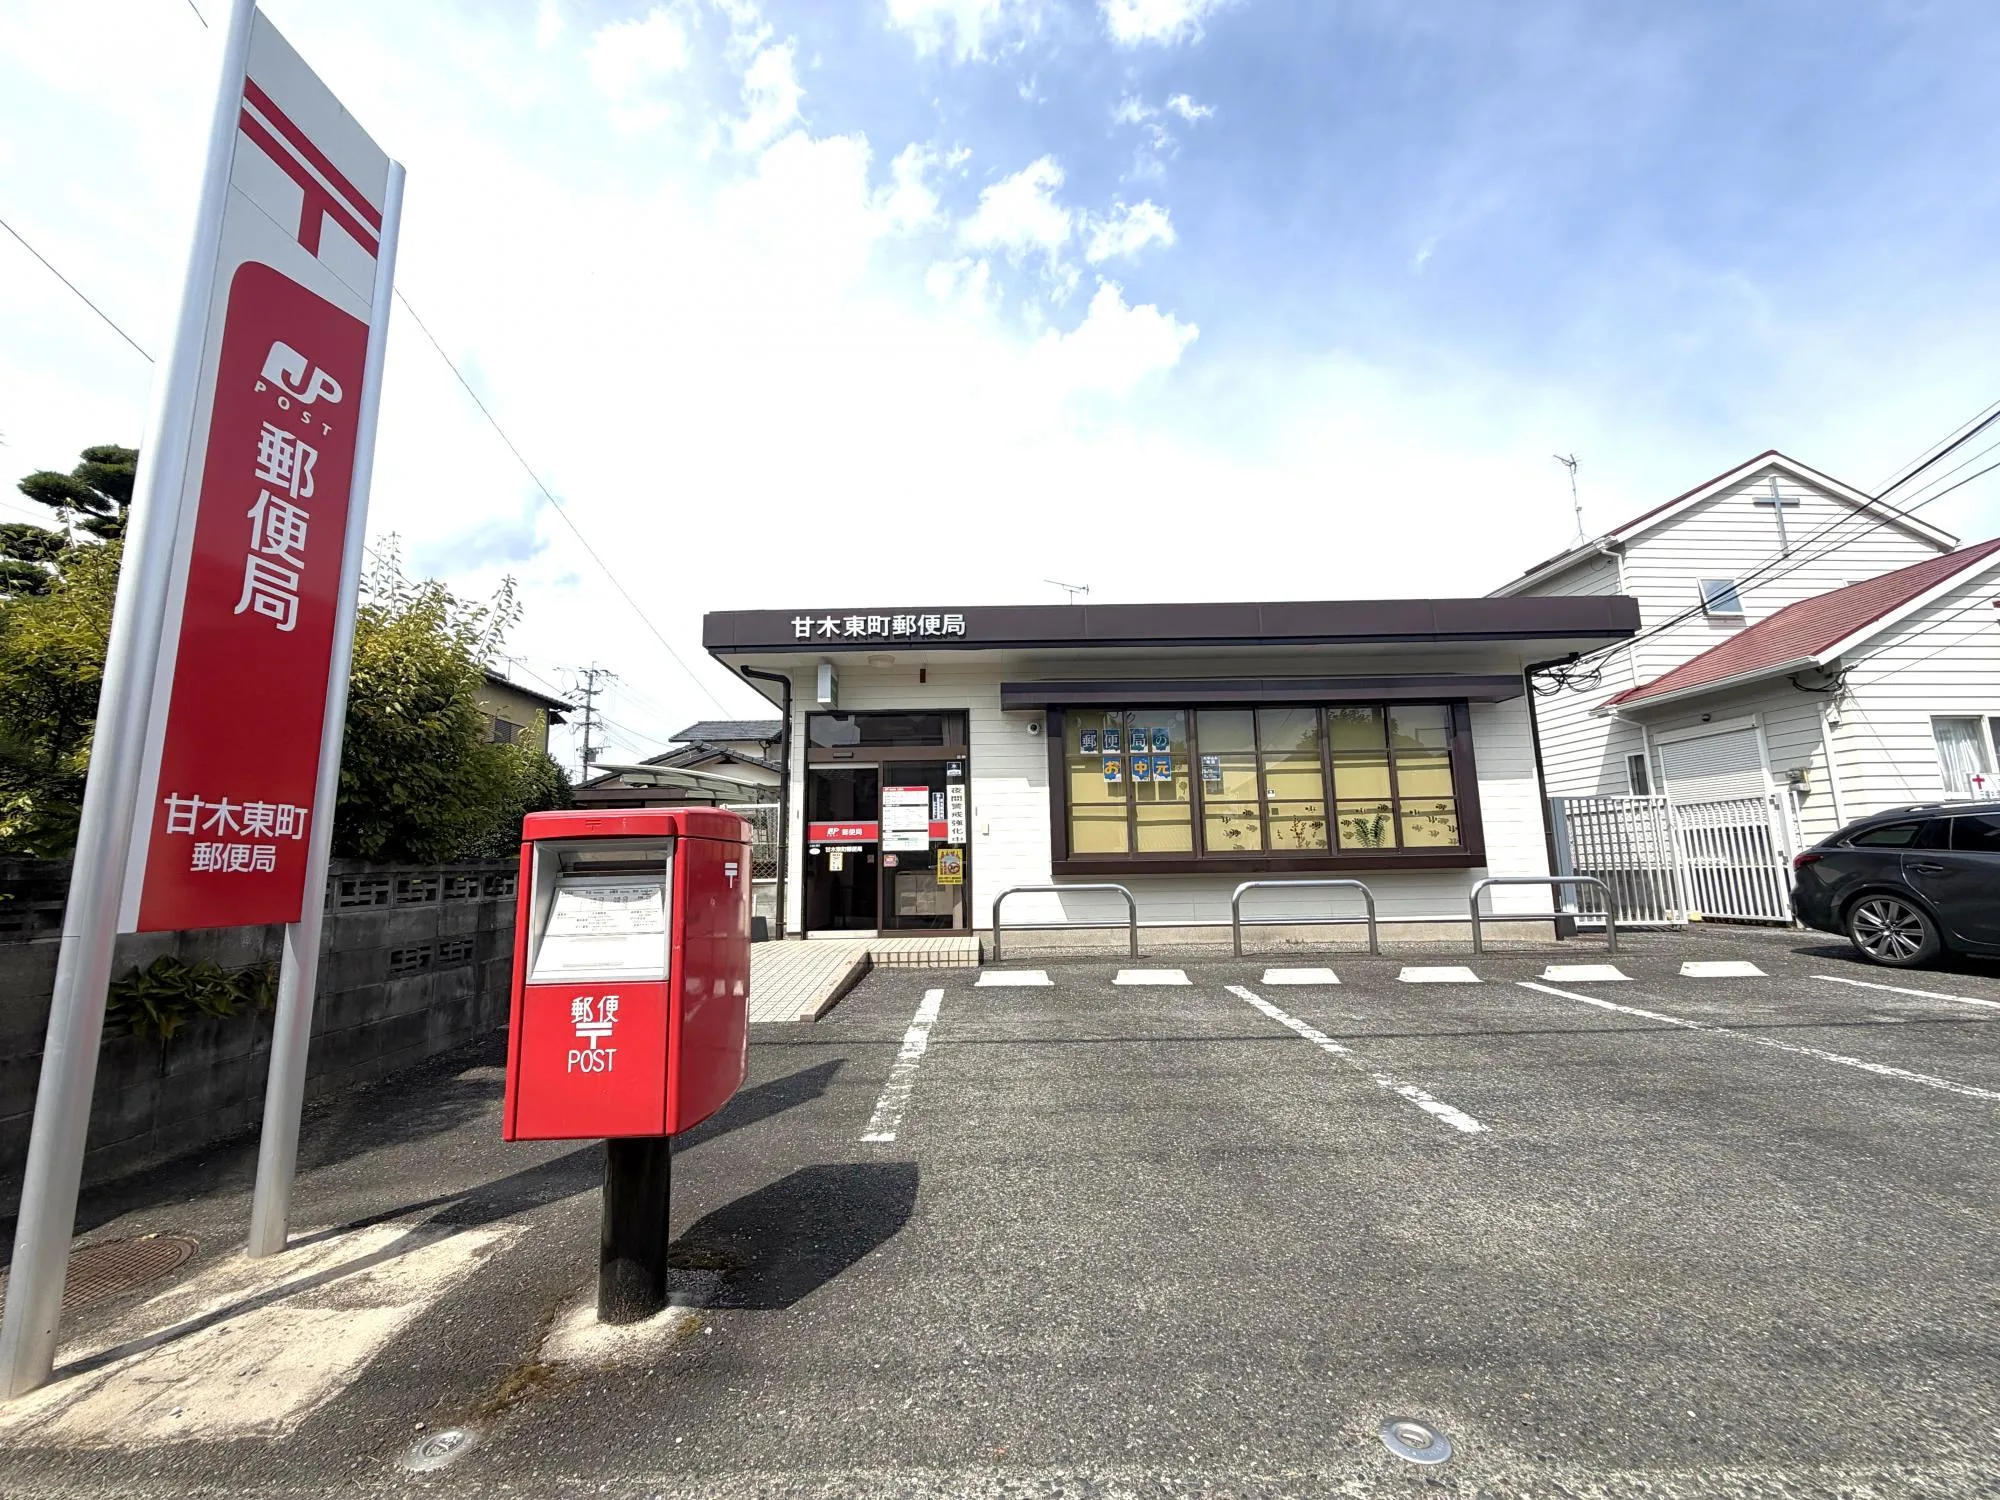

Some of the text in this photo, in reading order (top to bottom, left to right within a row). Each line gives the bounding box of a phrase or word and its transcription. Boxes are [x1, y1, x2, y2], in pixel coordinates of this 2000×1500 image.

[254, 380, 332, 436] POST
[234, 421, 318, 632] 郵便局
[791, 614, 966, 638] 甘木東町郵便局
[164, 792, 308, 840] 甘木東町
[190, 842, 277, 873] 郵便局
[571, 995, 620, 1023] 郵便
[567, 1048, 618, 1073] POST
